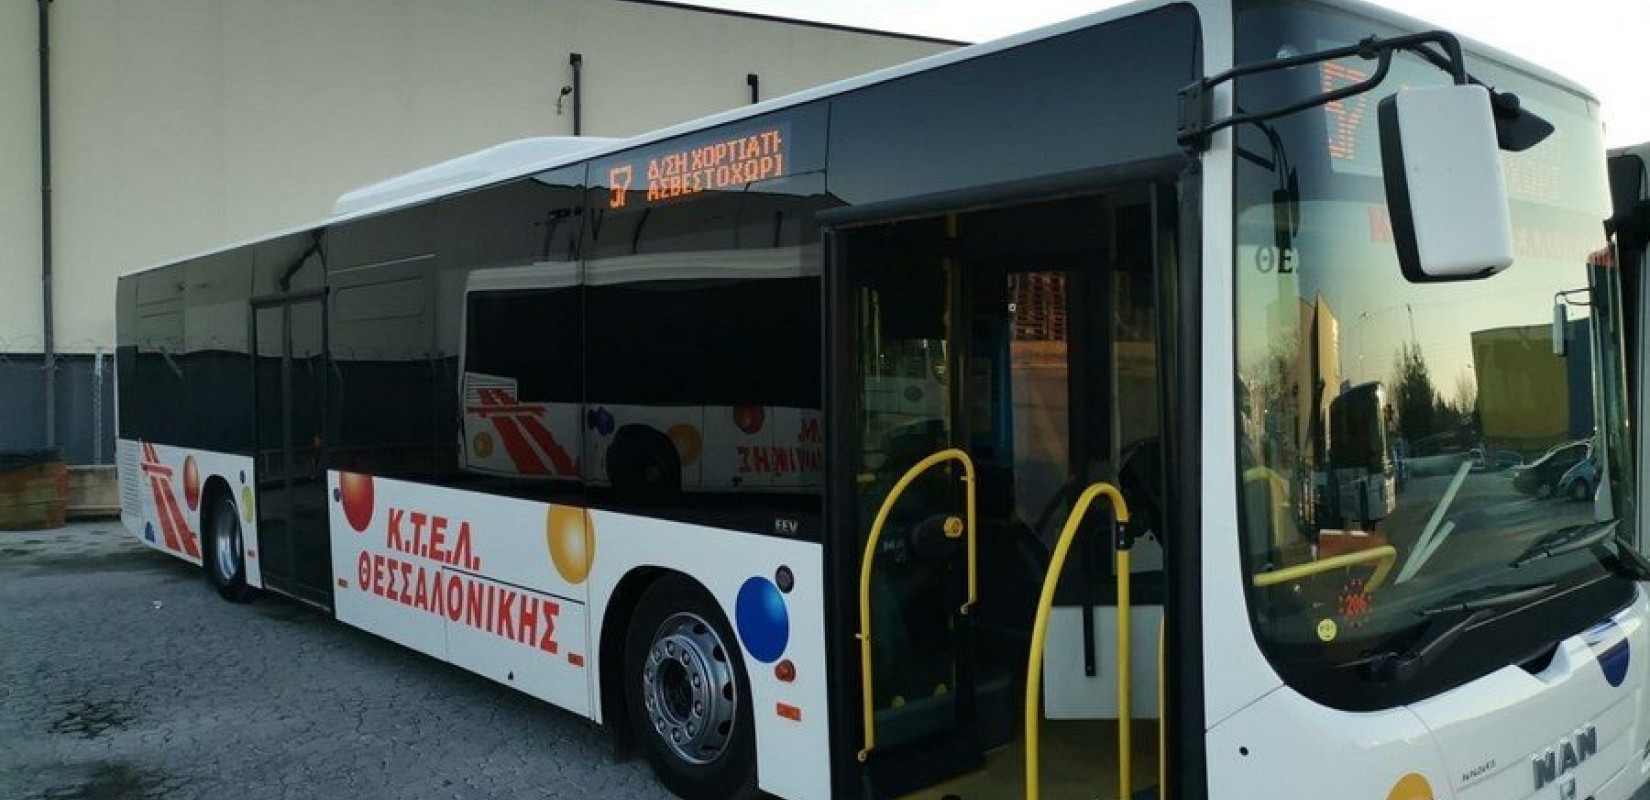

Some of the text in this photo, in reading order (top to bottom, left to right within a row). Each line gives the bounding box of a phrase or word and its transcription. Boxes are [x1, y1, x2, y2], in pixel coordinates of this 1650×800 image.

[609, 164, 632, 208] 57
[387, 507, 481, 571] Κ.Τ.Ε.Λ.
[358, 550, 560, 654] ΘΕΣΣΑΛΟΝΙΚΗΣ
[1532, 722, 1597, 790] MAN
